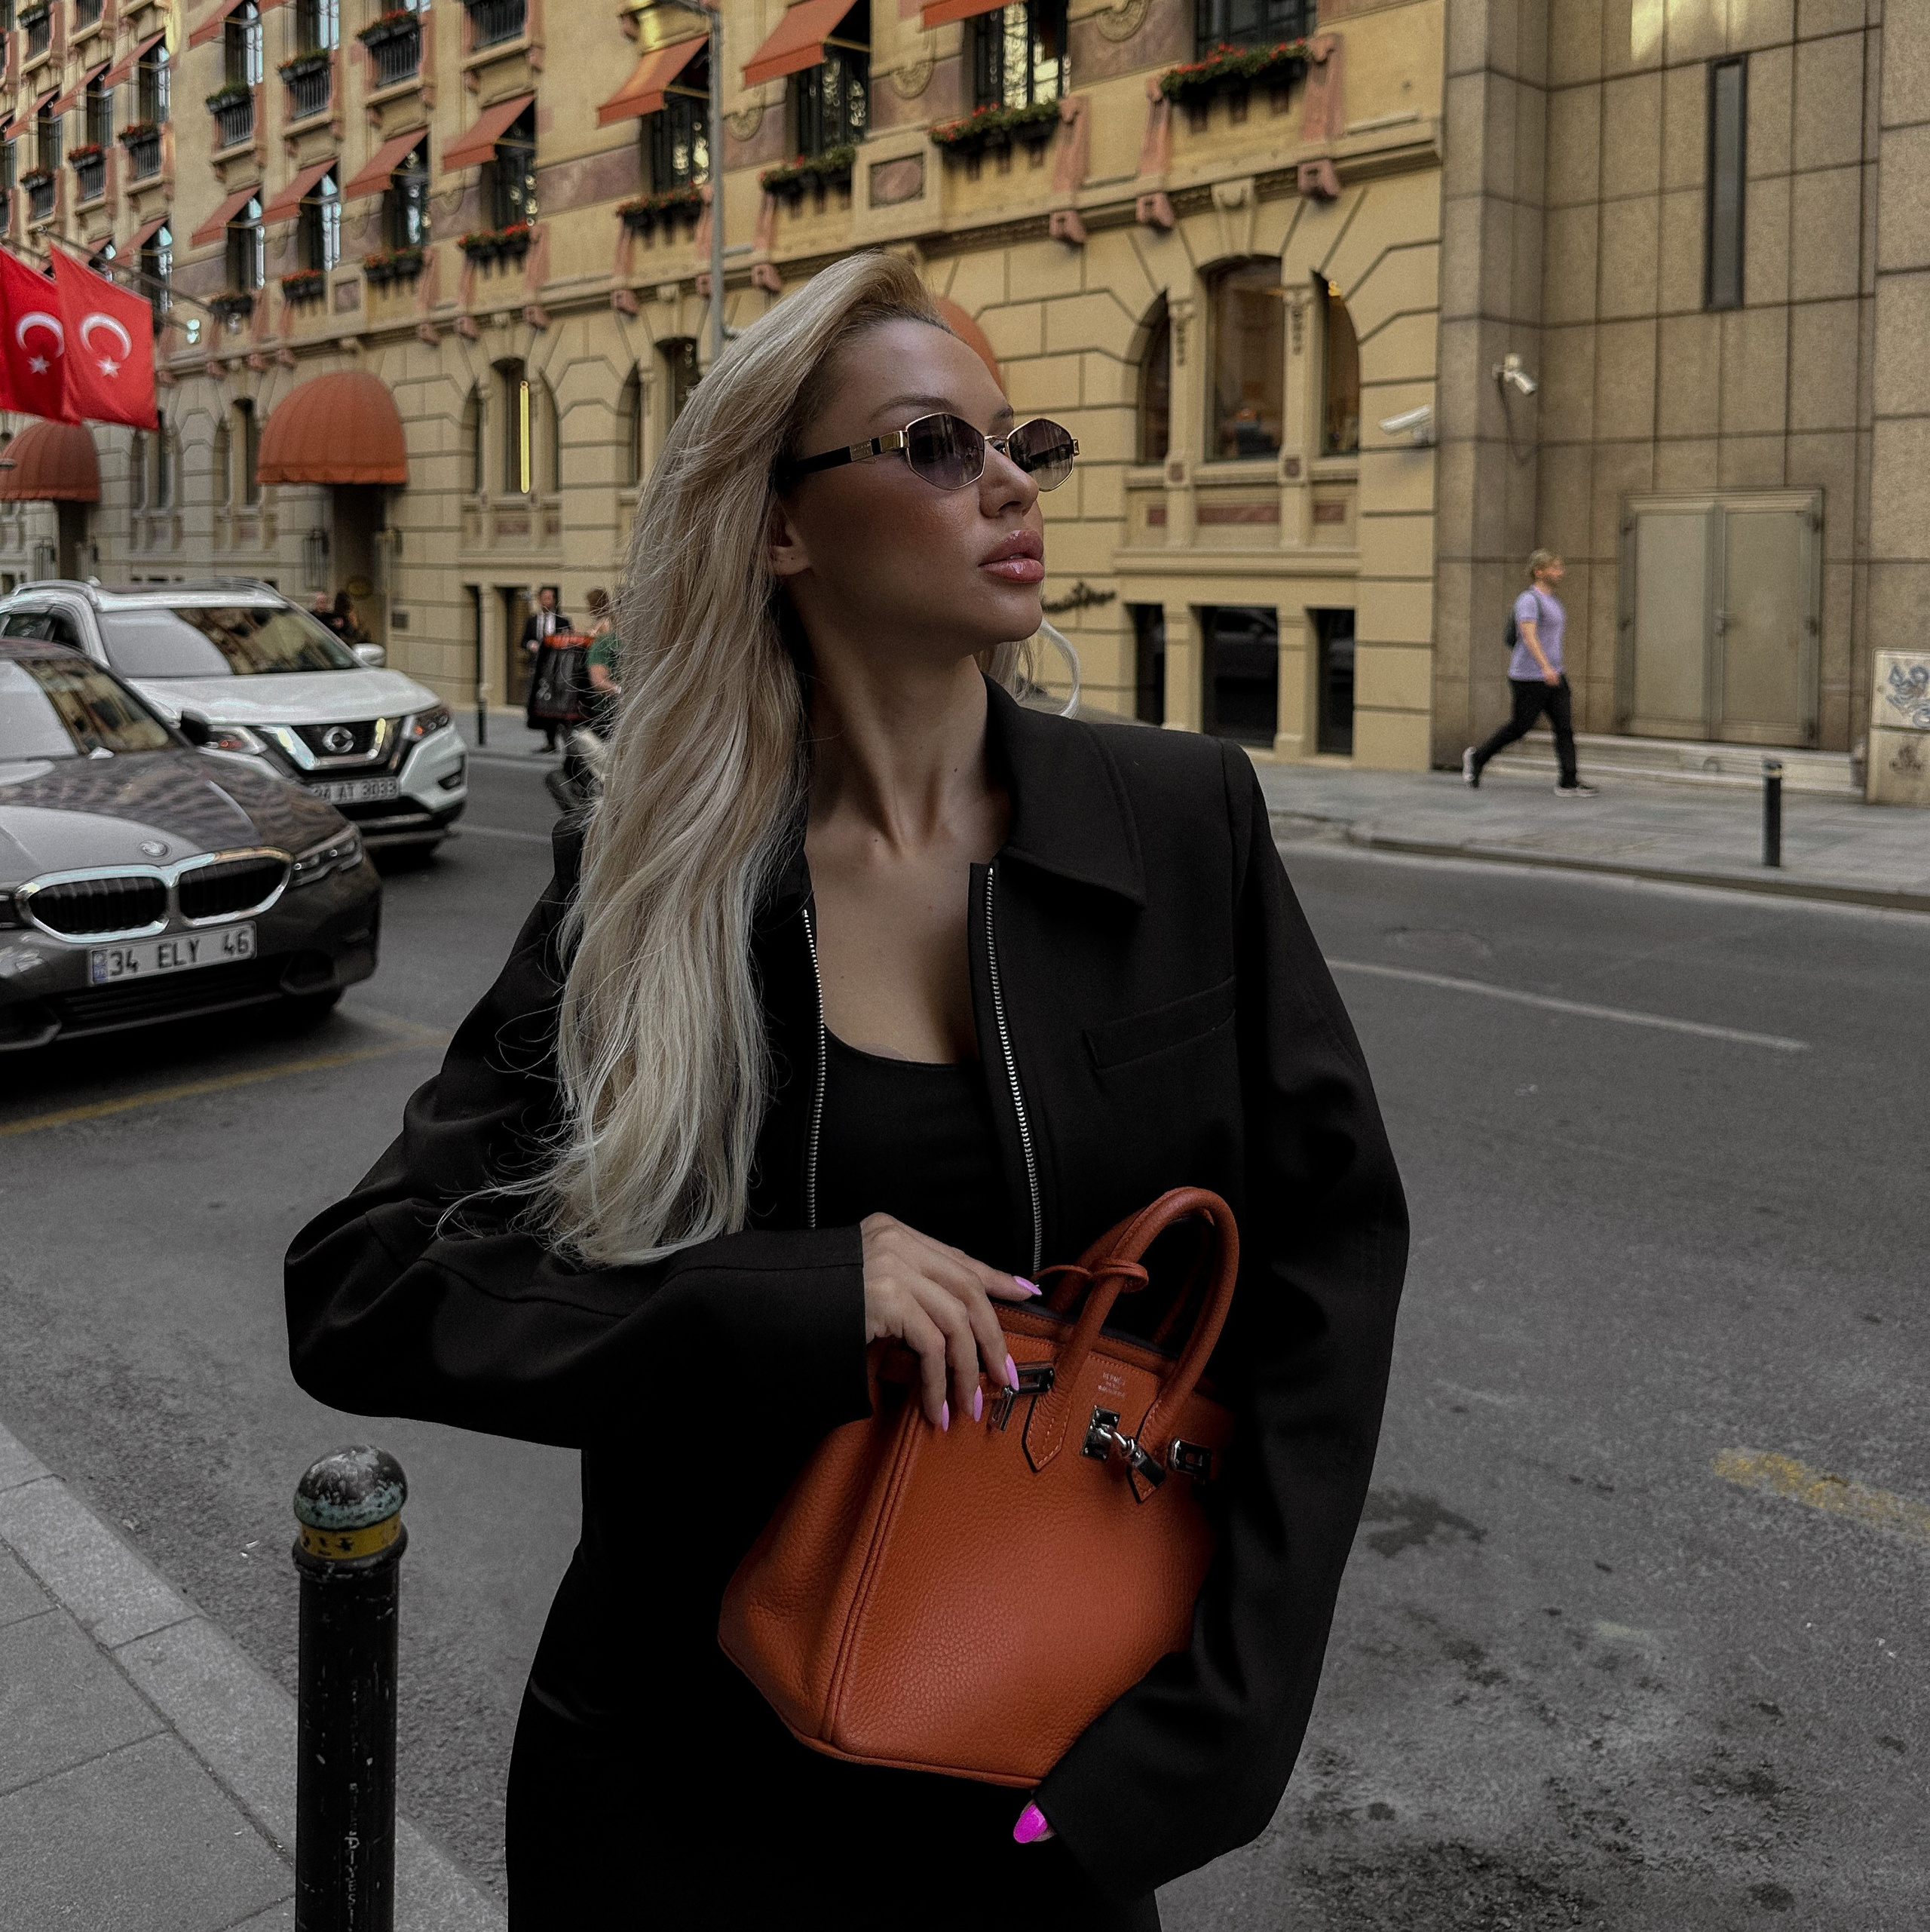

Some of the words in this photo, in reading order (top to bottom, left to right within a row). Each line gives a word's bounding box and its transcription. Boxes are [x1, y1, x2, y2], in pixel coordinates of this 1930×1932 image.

[110, 949, 139, 976] 34
[158, 938, 199, 969] ELY
[222, 930, 250, 955] 46
